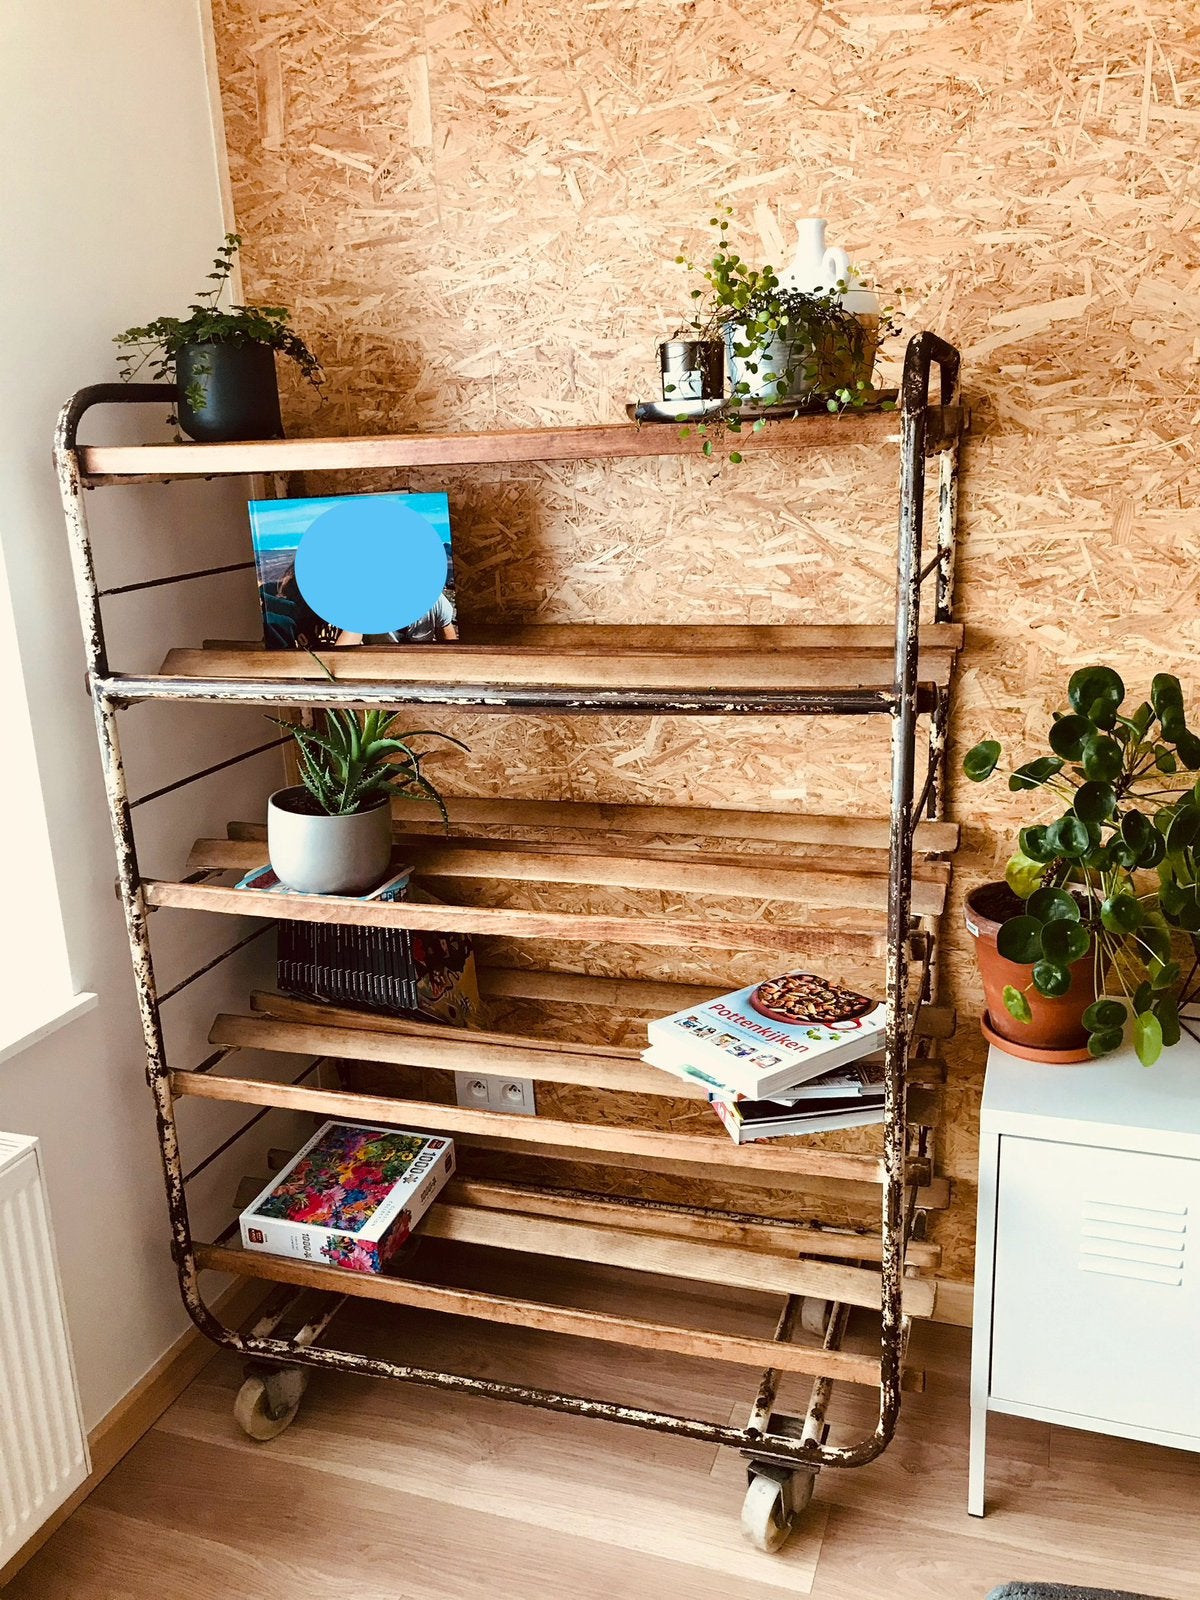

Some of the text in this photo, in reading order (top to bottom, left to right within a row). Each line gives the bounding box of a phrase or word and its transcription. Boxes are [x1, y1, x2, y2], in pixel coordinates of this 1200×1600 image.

[708, 1003, 809, 1053] Pottenkijken
[410, 1151, 436, 1174] 1000
[302, 1233, 311, 1251] 1000
